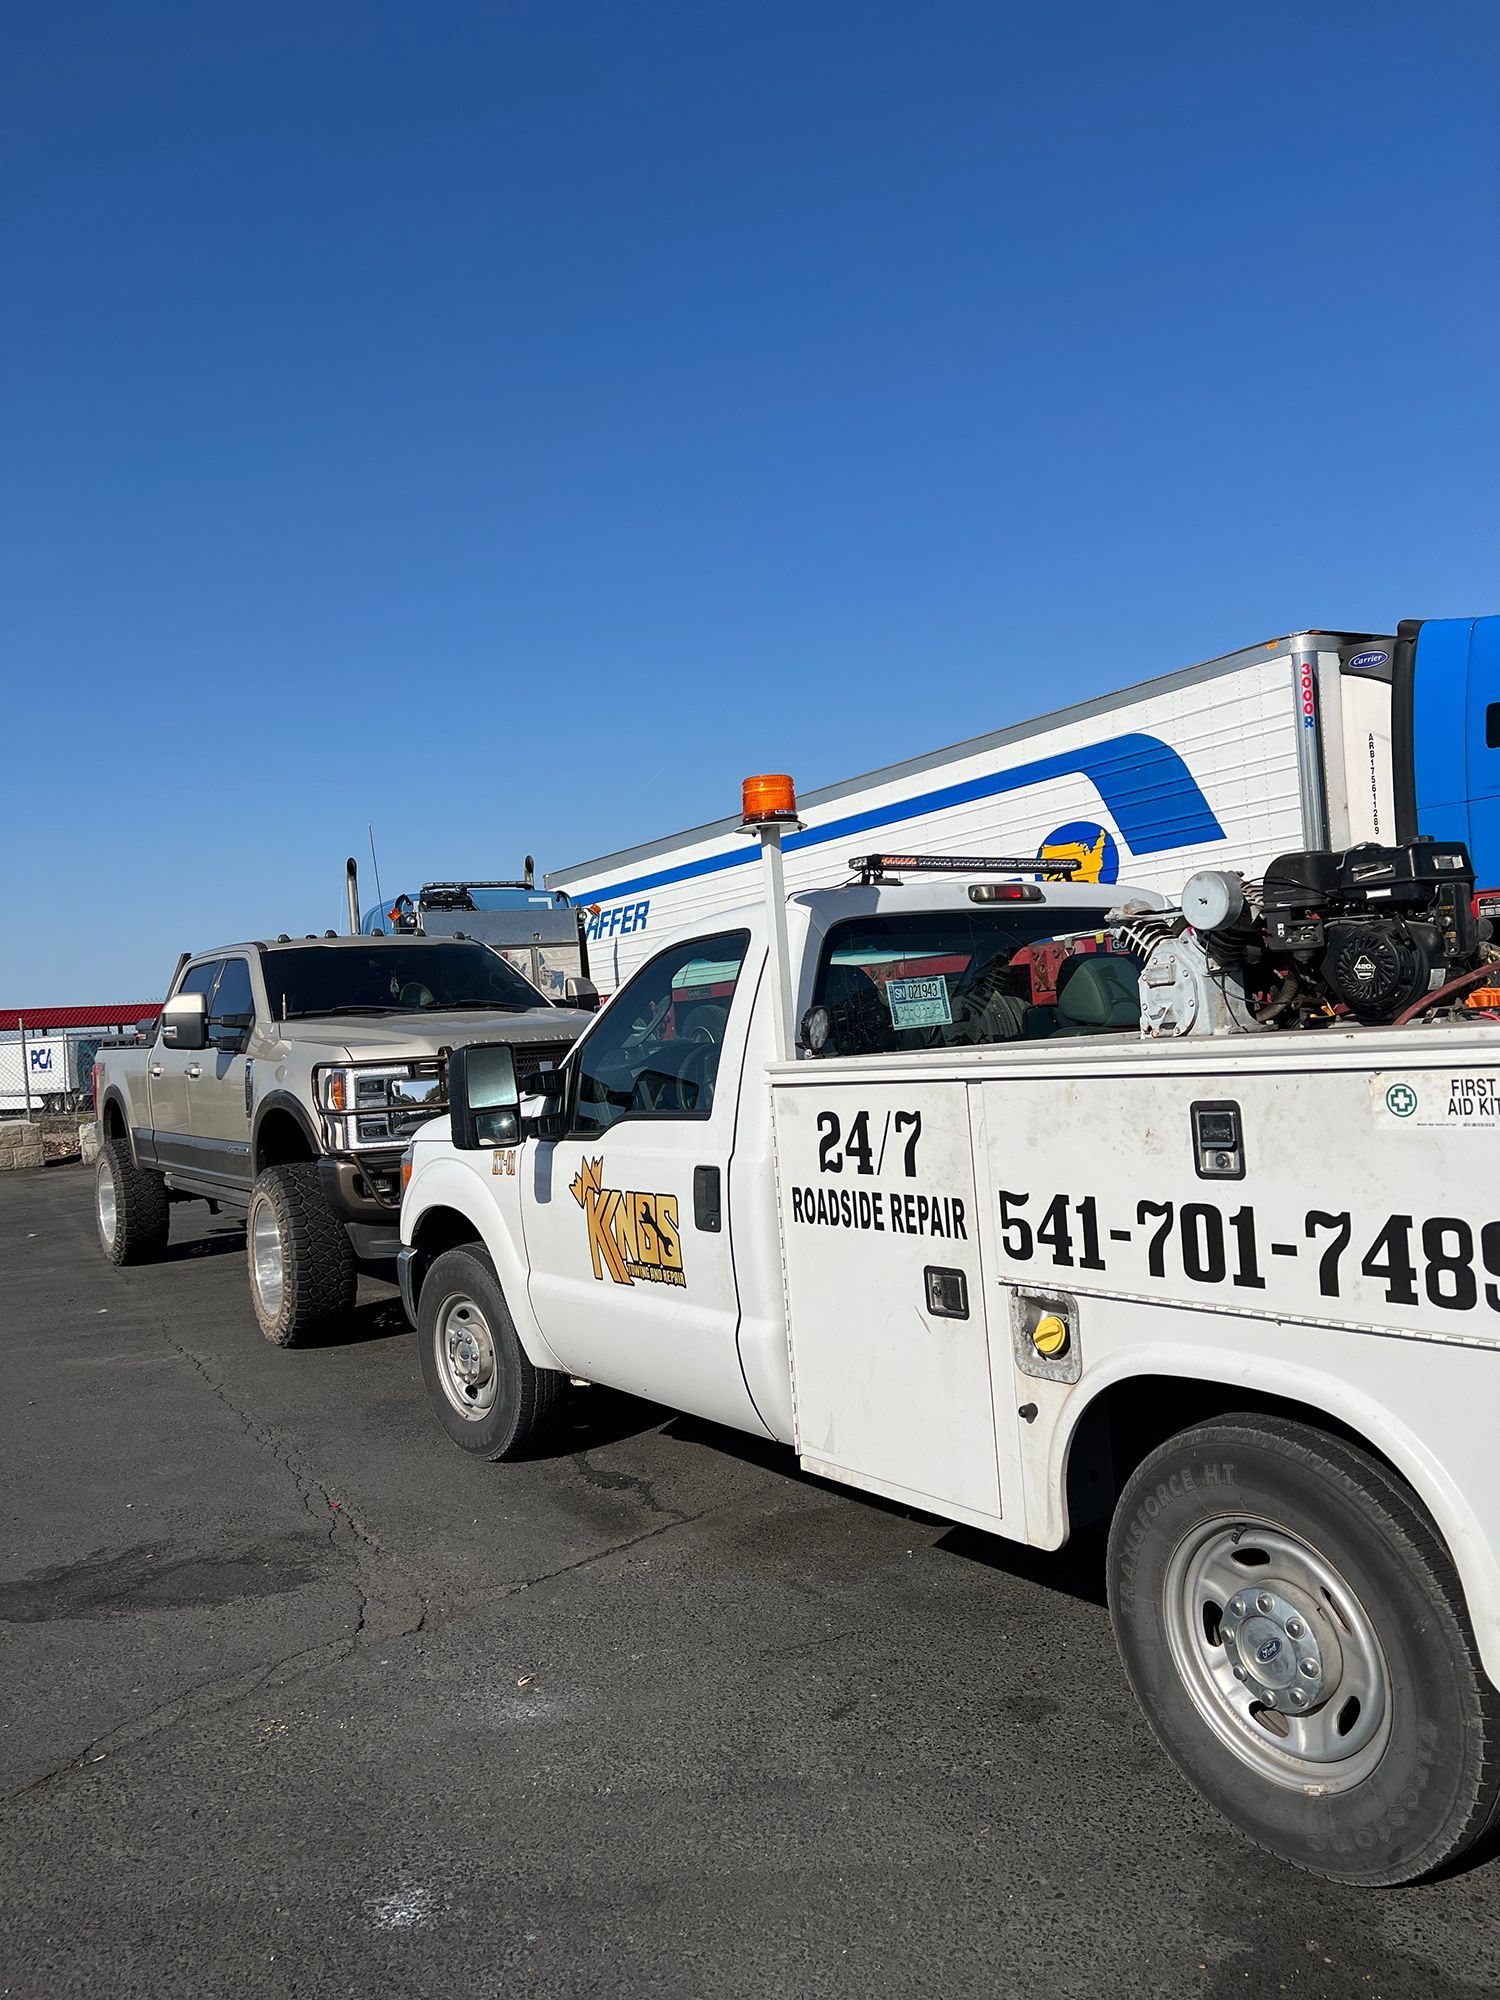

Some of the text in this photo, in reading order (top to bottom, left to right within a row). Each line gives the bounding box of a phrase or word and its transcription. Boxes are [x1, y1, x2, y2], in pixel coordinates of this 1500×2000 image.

[1353, 654, 1383, 666] Carrier
[1300, 662, 1315, 729] 3000R
[1368, 732, 1380, 835] ARB175611289
[908, 982, 938, 999] 021943
[31, 1048, 52, 1070] PCA
[1450, 1078, 1496, 1097] FIRST
[1447, 1097, 1474, 1116] AID
[816, 1110, 922, 1178] 24/7
[791, 1186, 968, 1241] ROADSIDE REPAIR
[662, 1269, 687, 1287] REPAIR
